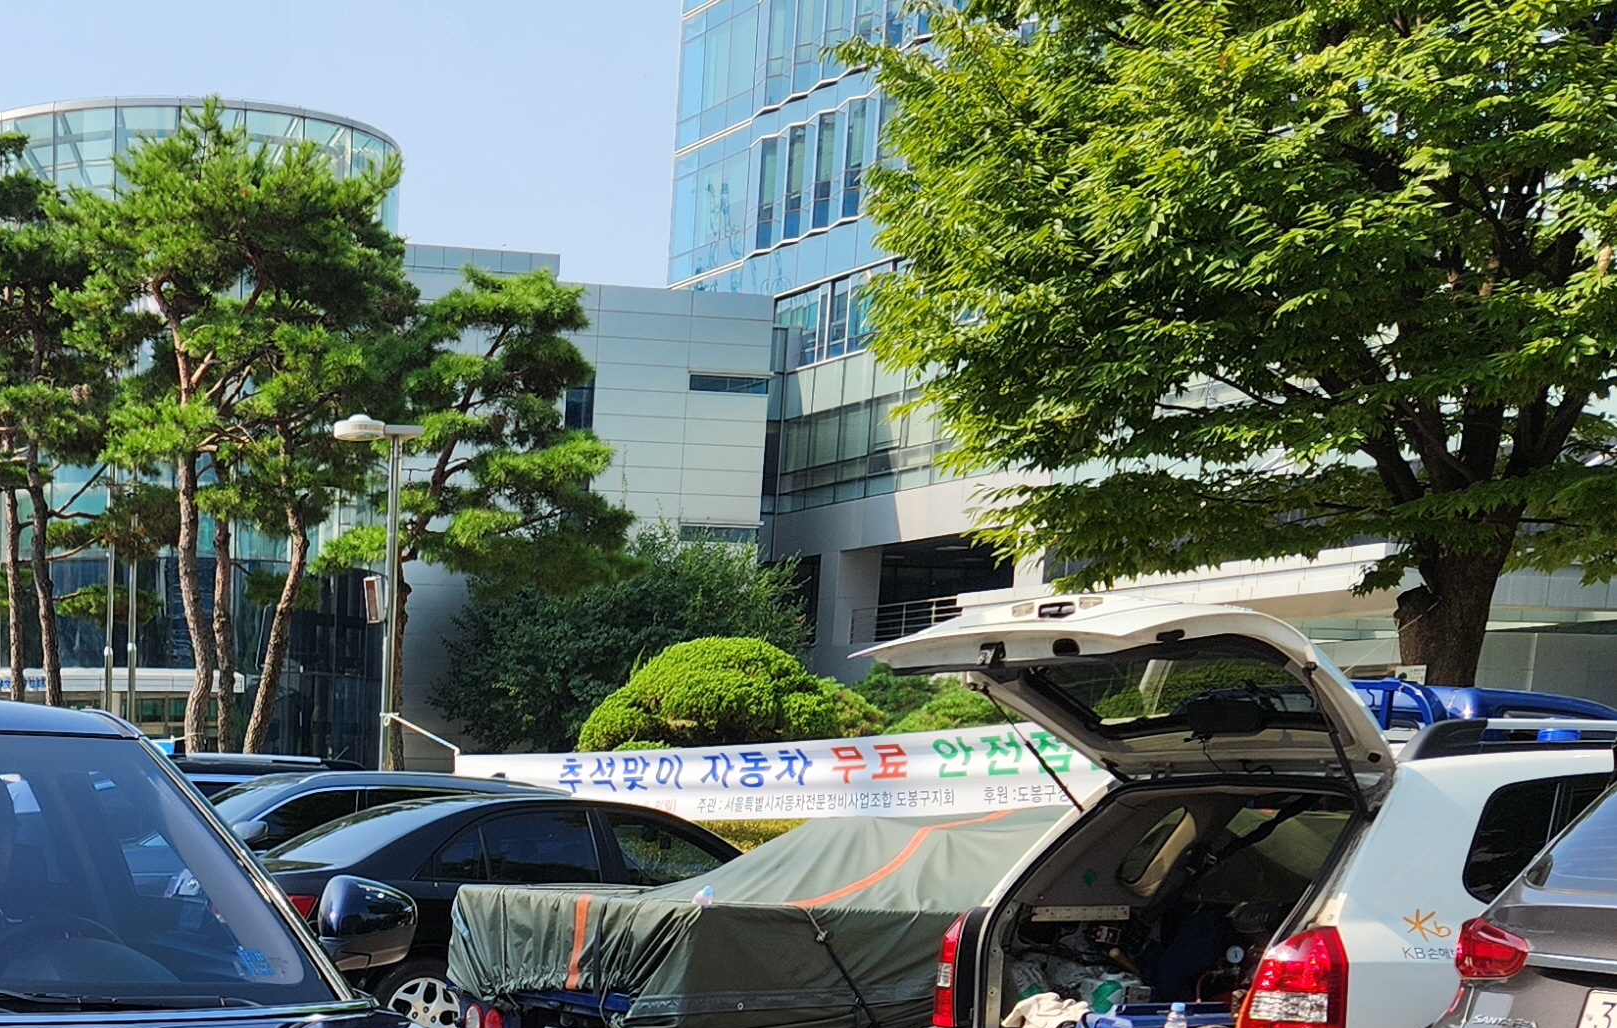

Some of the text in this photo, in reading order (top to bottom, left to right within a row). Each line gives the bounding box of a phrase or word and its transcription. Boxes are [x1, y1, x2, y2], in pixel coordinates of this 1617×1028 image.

[558, 731, 1100, 793] 추석맞이 자동차 무료 안전점
[697, 798, 716, 813] 주관
[724, 791, 892, 813] 서울특별시자동차전문정비사업조합
[896, 788, 955, 808] 도봉구지회
[984, 785, 1008, 804] 후원
[1471, 1013, 1511, 1028] SANTA
